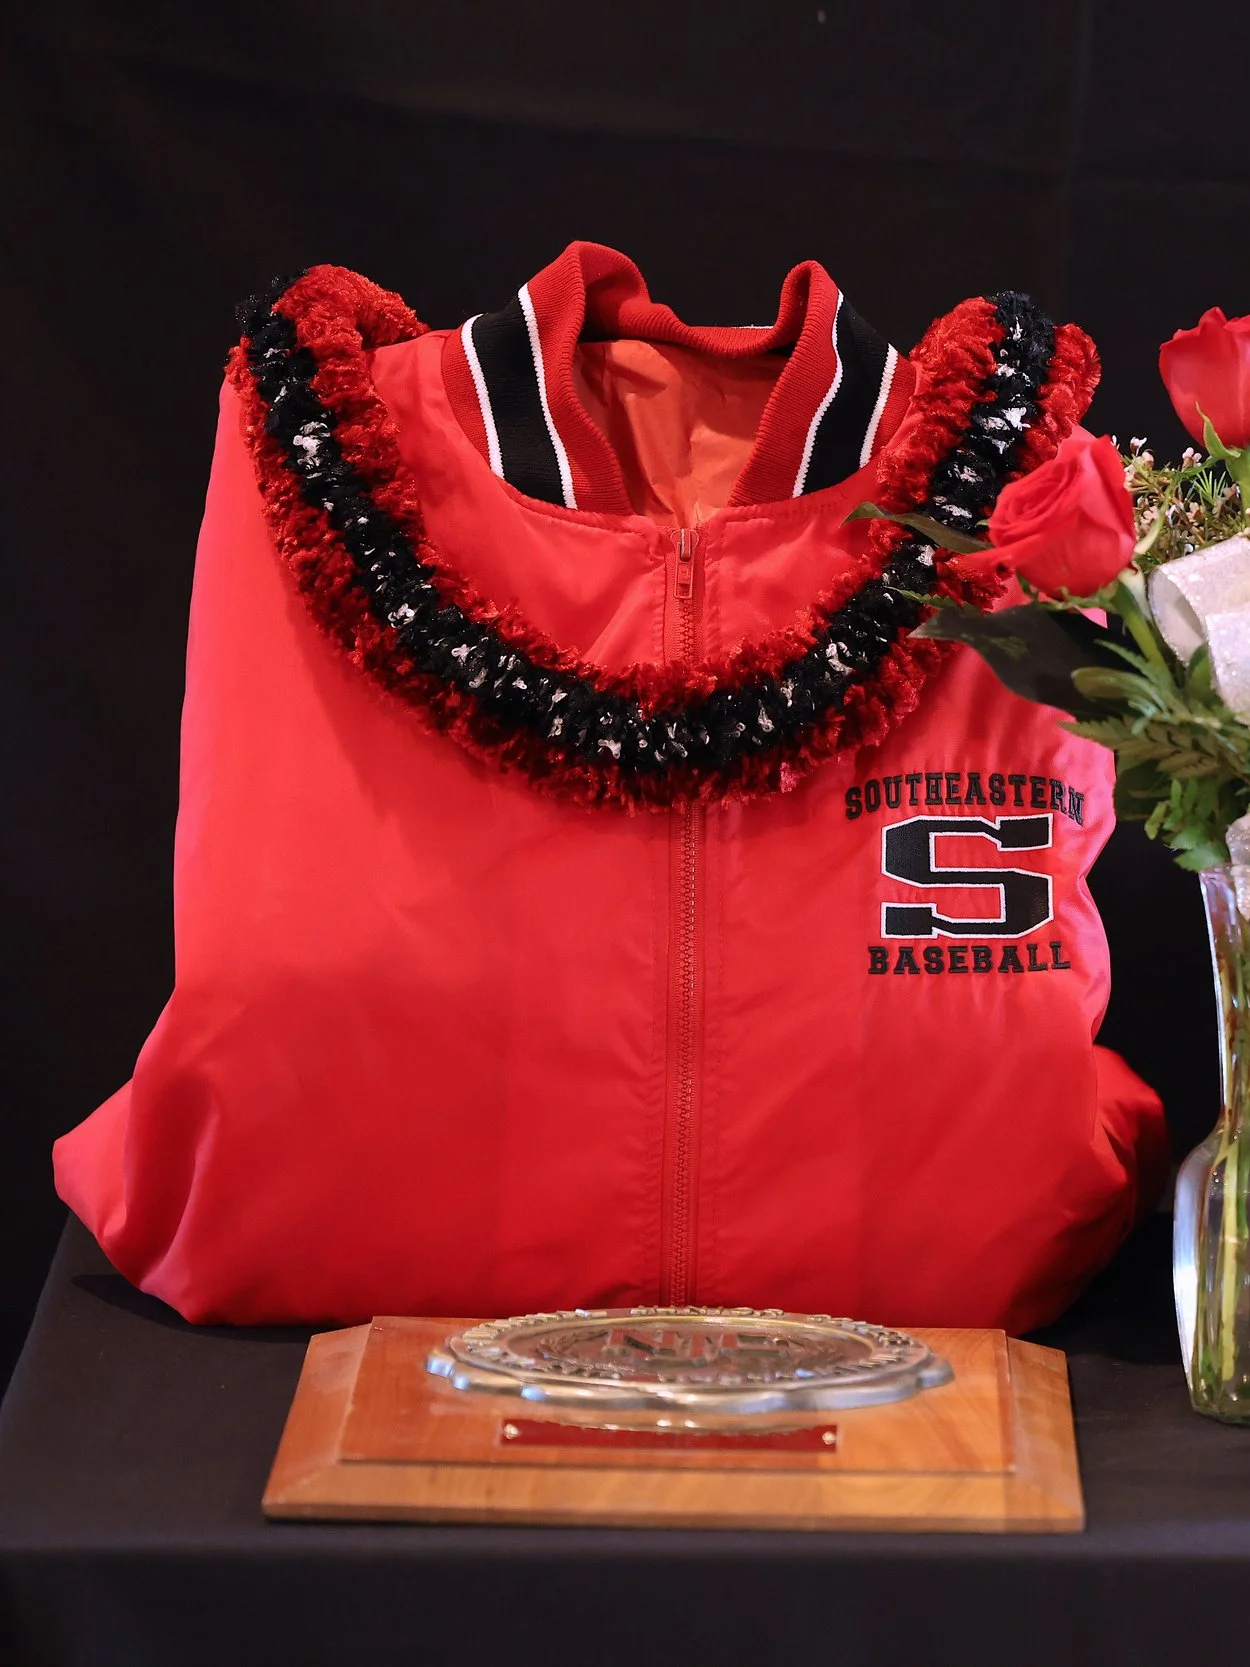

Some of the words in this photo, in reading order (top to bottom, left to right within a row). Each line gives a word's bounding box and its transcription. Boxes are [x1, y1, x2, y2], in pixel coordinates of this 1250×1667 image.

[845, 772, 1085, 826] SOUTHEASTERN
[881, 812, 1054, 939] S
[868, 941, 1071, 975] BASEBALL
